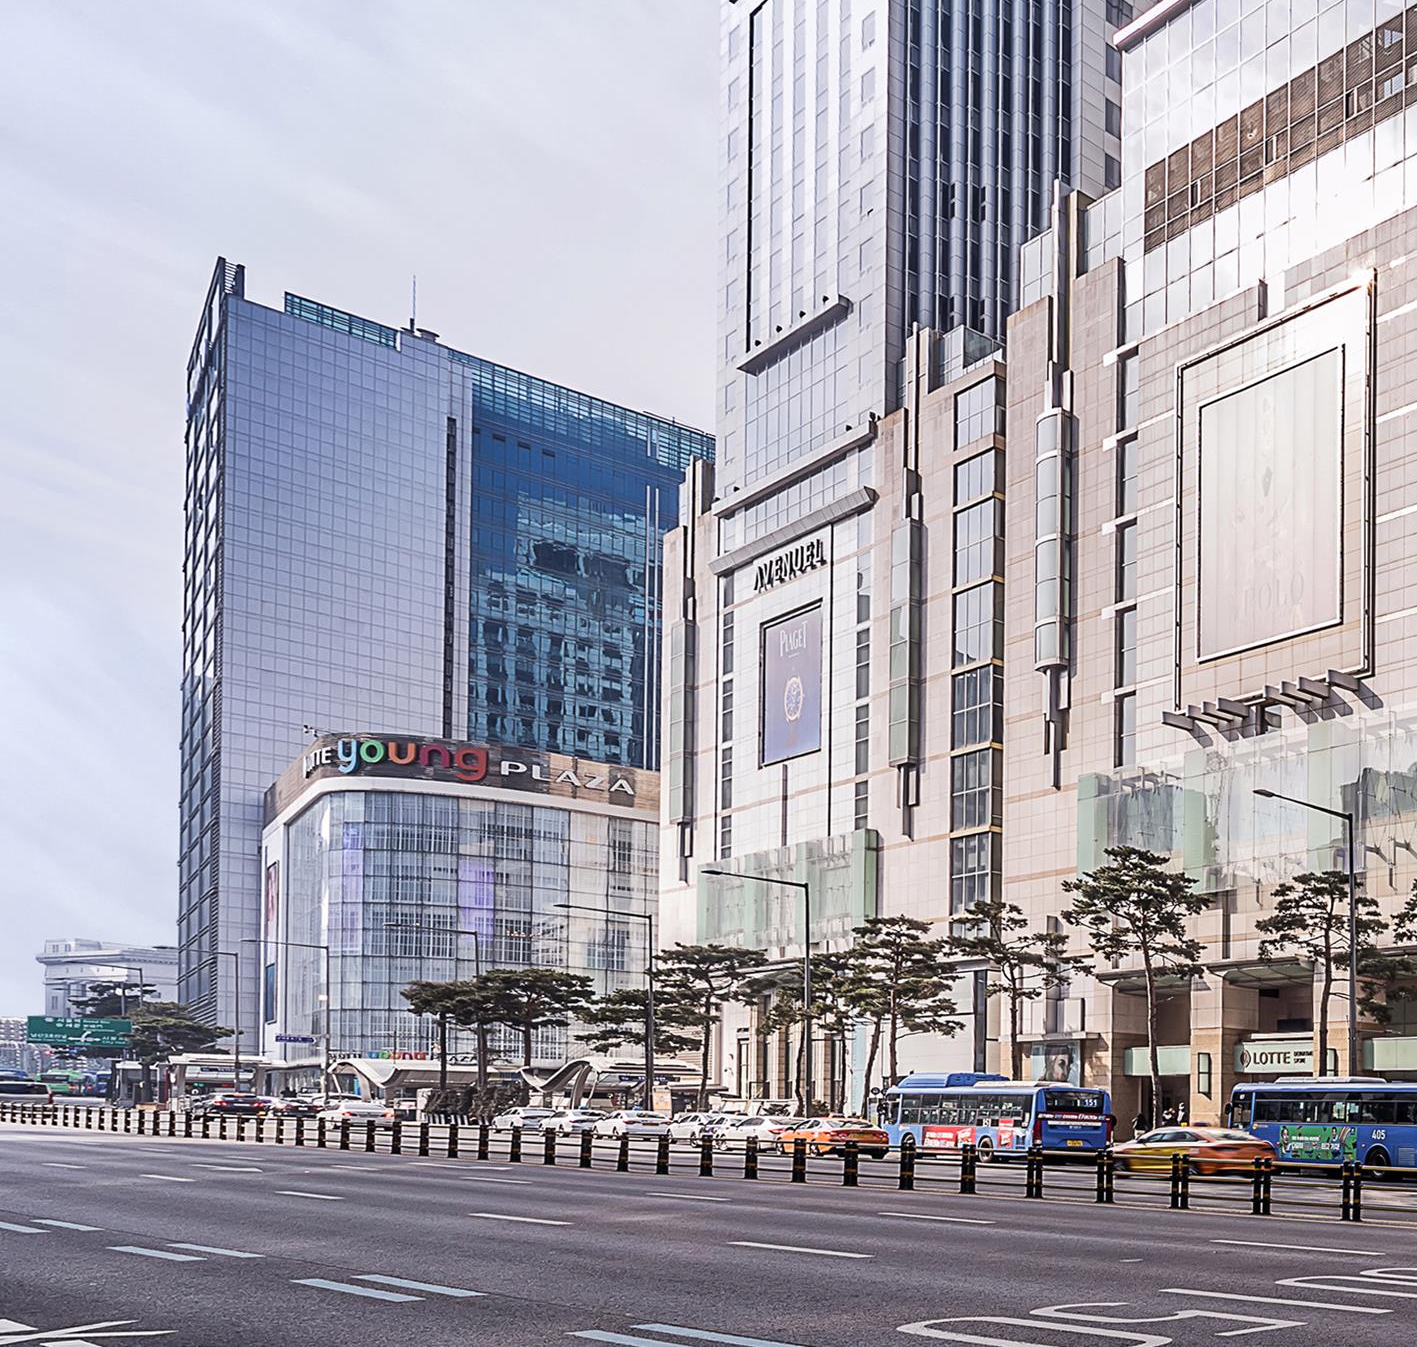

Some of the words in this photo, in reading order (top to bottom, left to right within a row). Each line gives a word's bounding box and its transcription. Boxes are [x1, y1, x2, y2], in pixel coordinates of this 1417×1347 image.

[753, 538, 827, 593] AVENUEL
[780, 621, 808, 657] PIAGET
[337, 738, 488, 782] young
[500, 761, 635, 796] PLAZA
[1253, 1051, 1291, 1065] LOTTE
[1371, 1129, 1386, 1140] 405
